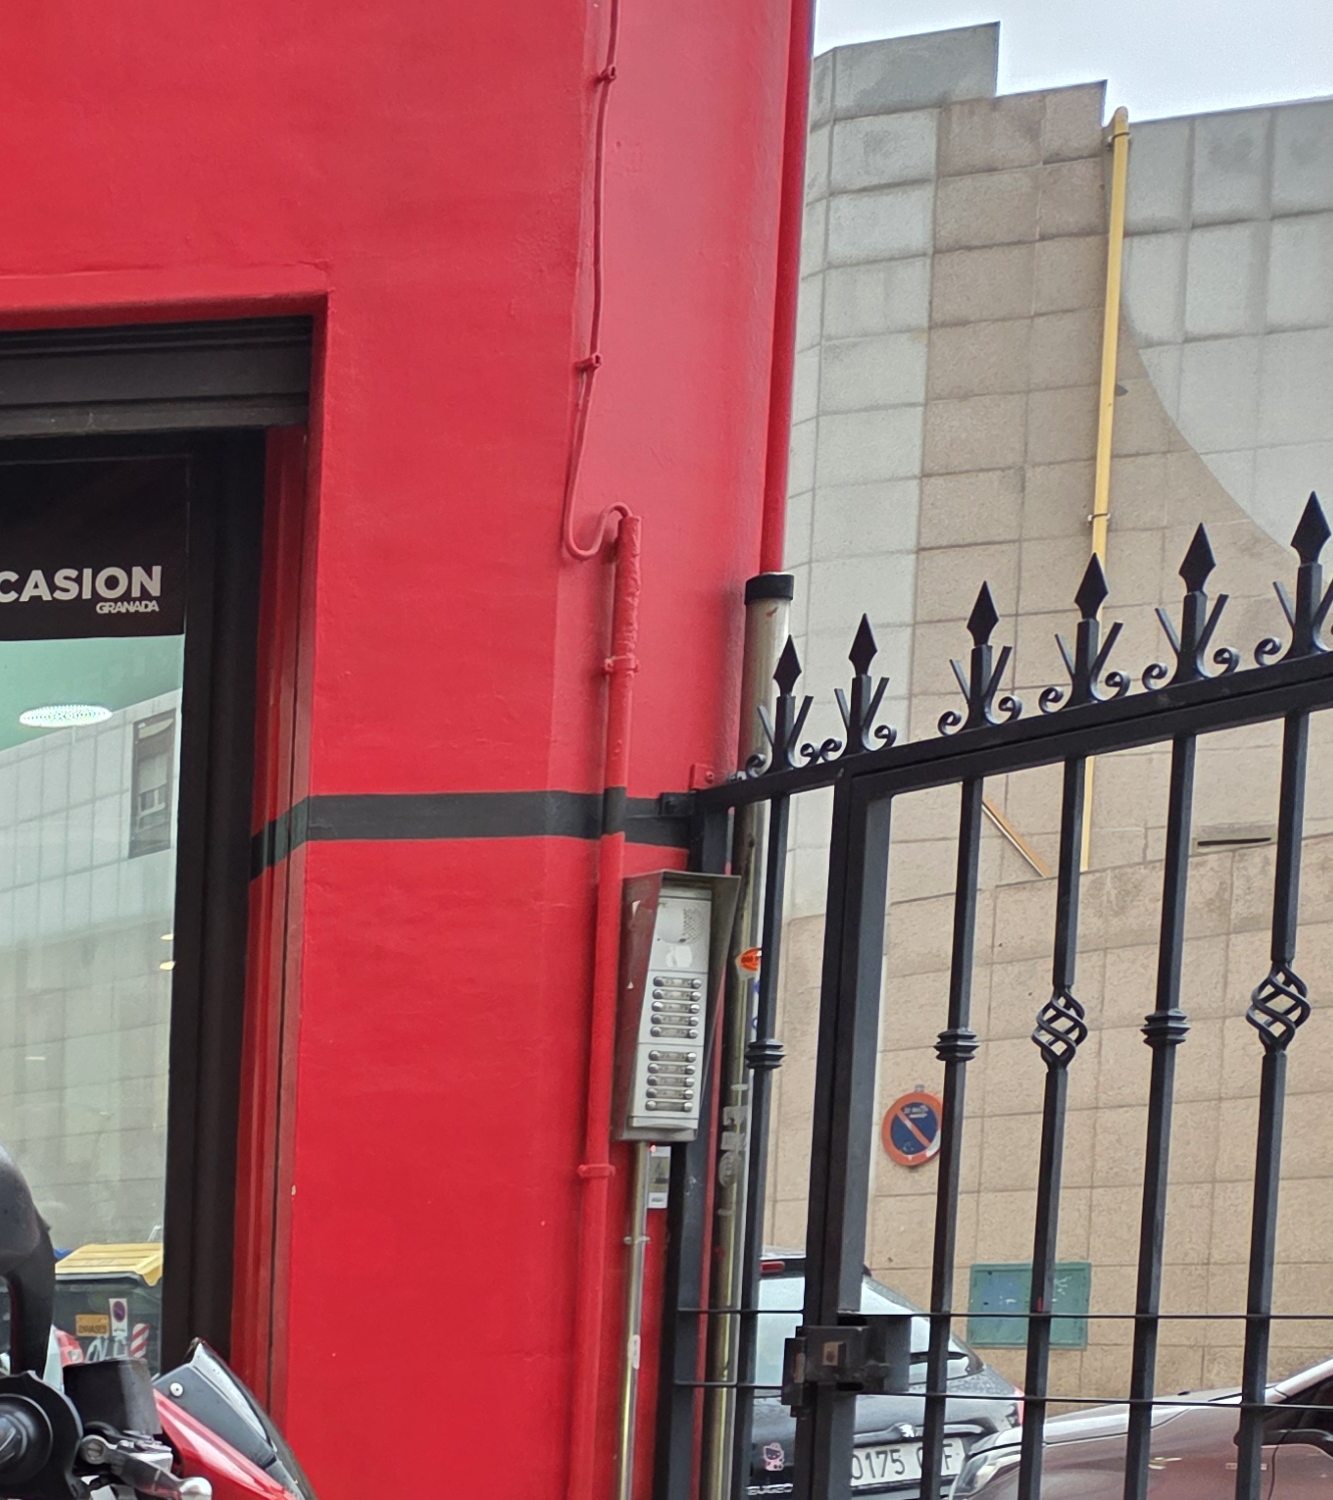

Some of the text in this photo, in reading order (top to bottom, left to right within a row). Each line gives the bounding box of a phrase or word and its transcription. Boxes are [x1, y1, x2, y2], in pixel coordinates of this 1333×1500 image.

[96, 600, 160, 614] GRANADA
[850, 1448, 906, 1481] 0175
[746, 1483, 794, 1496] EUGEO
